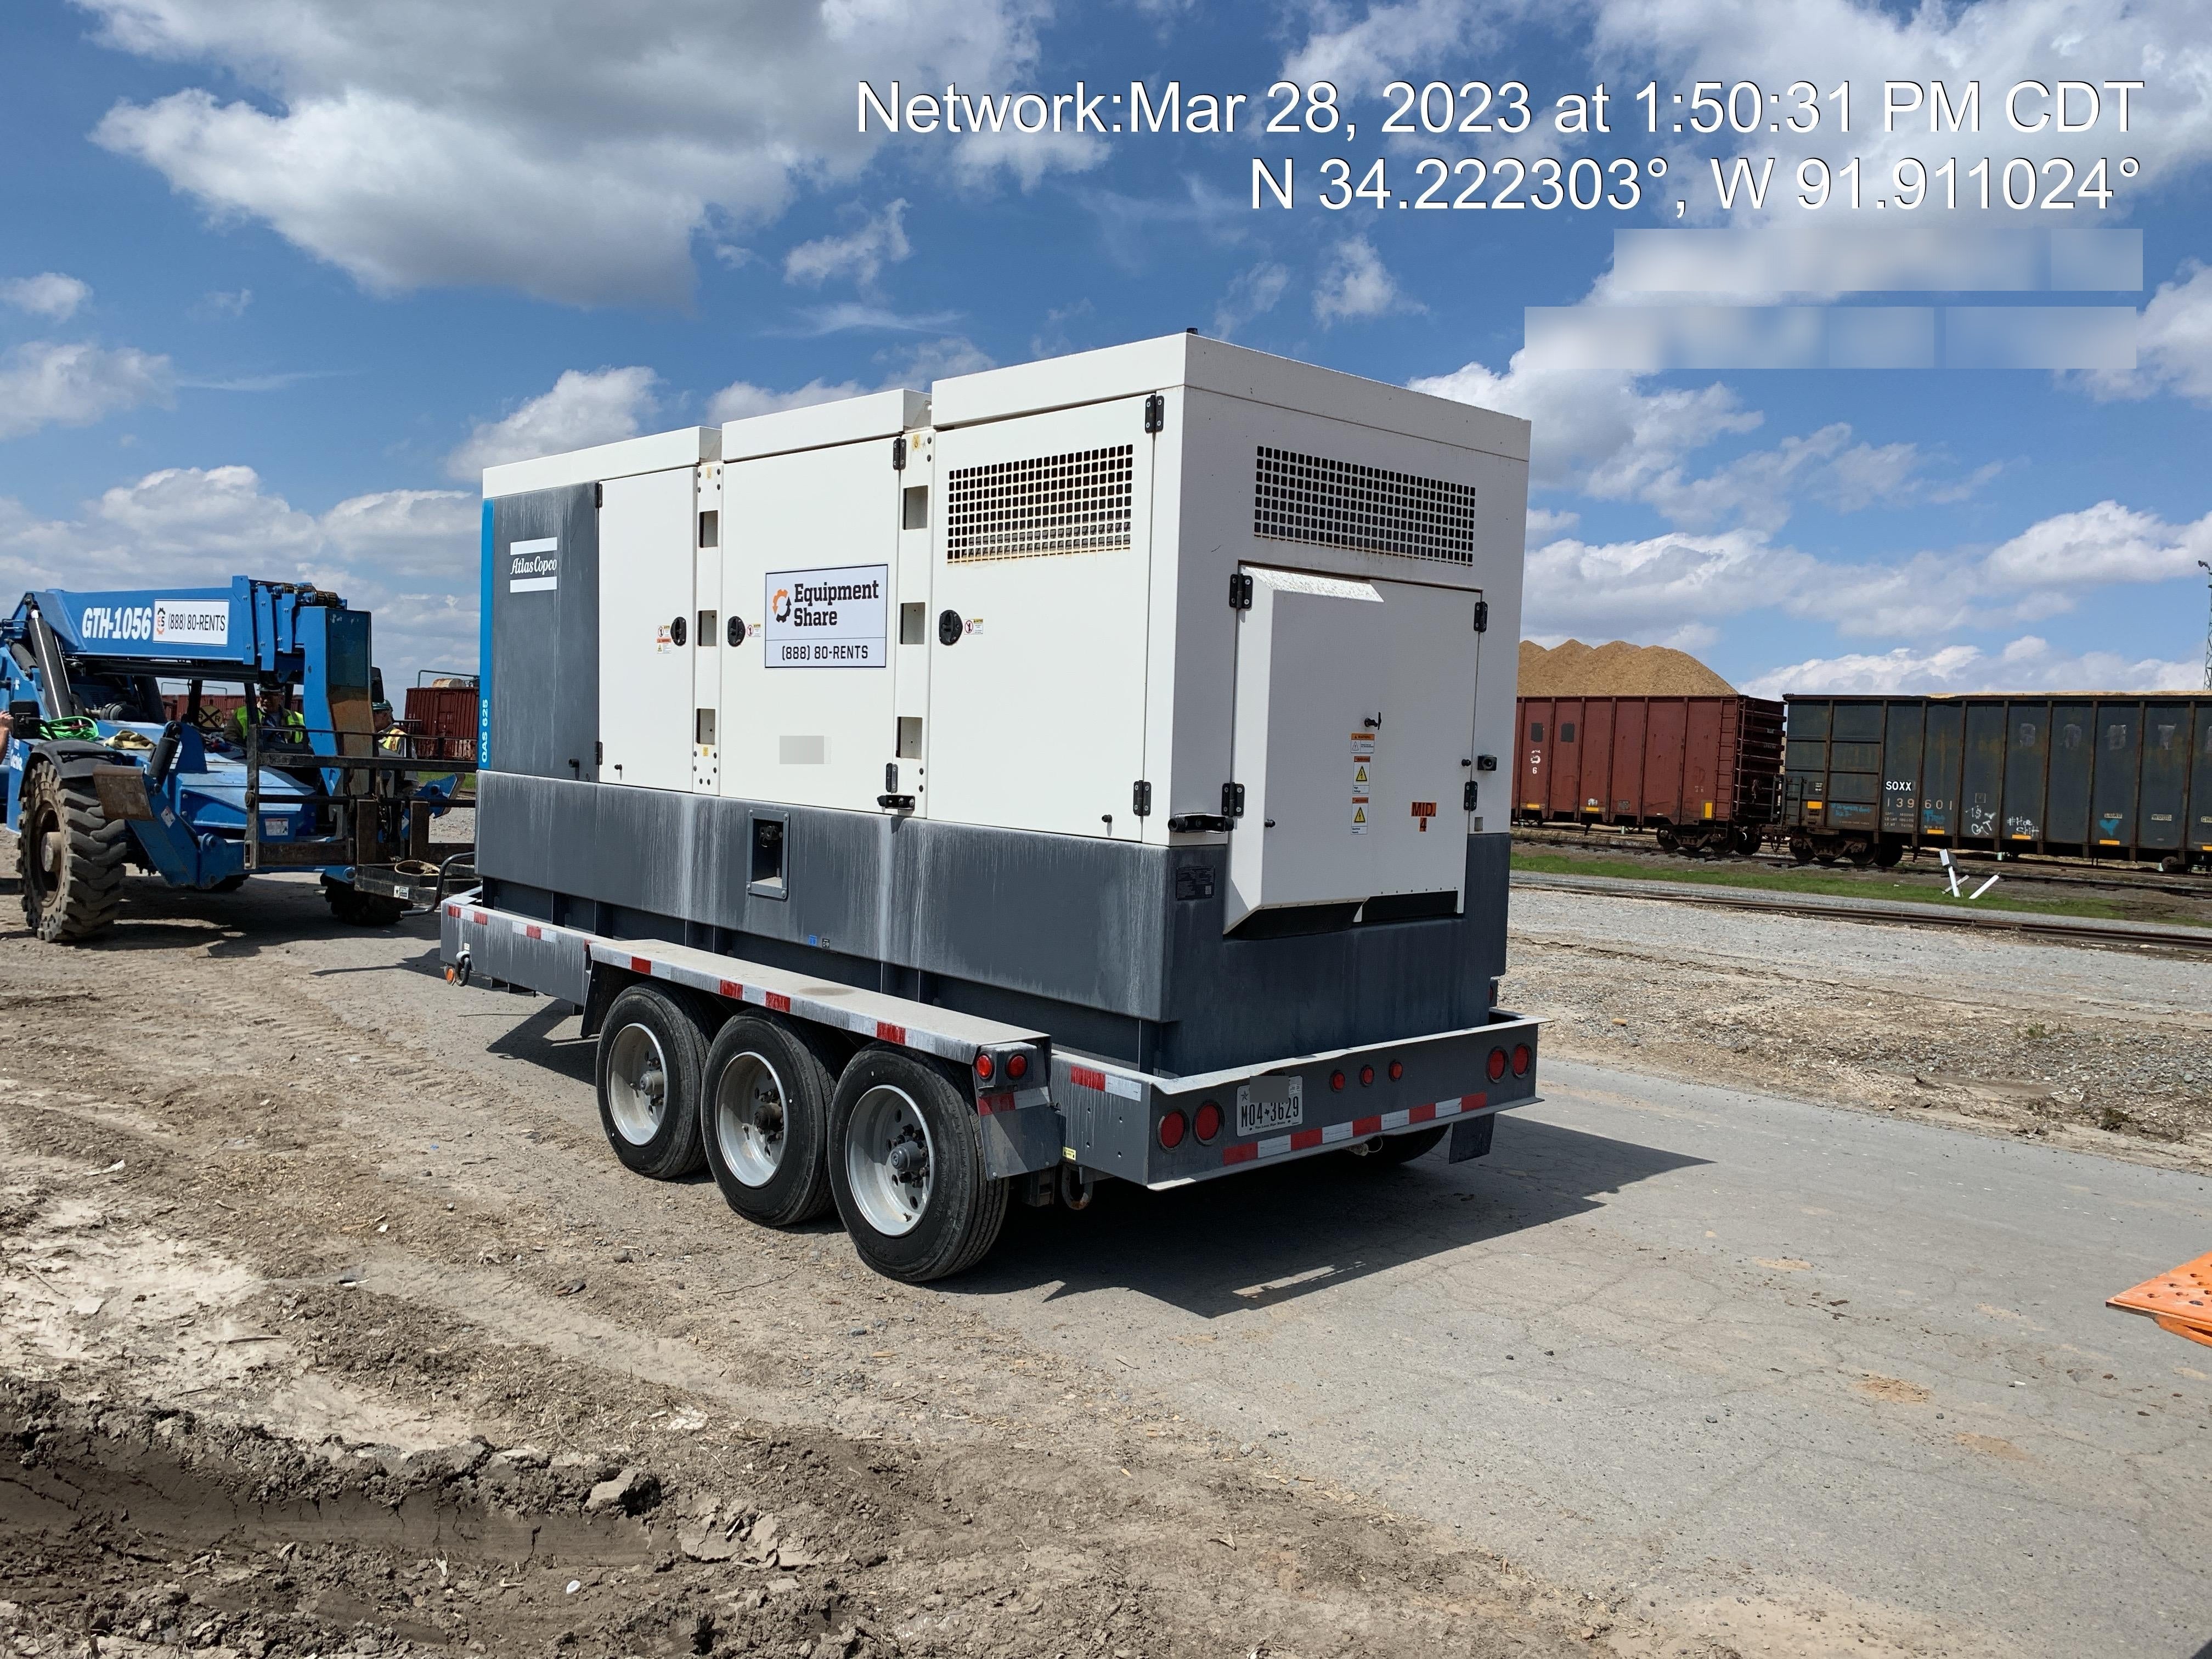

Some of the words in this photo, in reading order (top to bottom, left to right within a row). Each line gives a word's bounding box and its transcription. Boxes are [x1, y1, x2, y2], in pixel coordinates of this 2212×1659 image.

[794, 580, 879, 606] Equipment
[82, 607, 152, 640] GTH-1056
[168, 613, 186, 630] (888)
[187, 613, 226, 631] 80-RENTS
[794, 607, 837, 627] Share
[782, 645, 810, 661] (888)
[814, 645, 868, 659] 80-RENTS
[1886, 781, 1912, 791] SOXX
